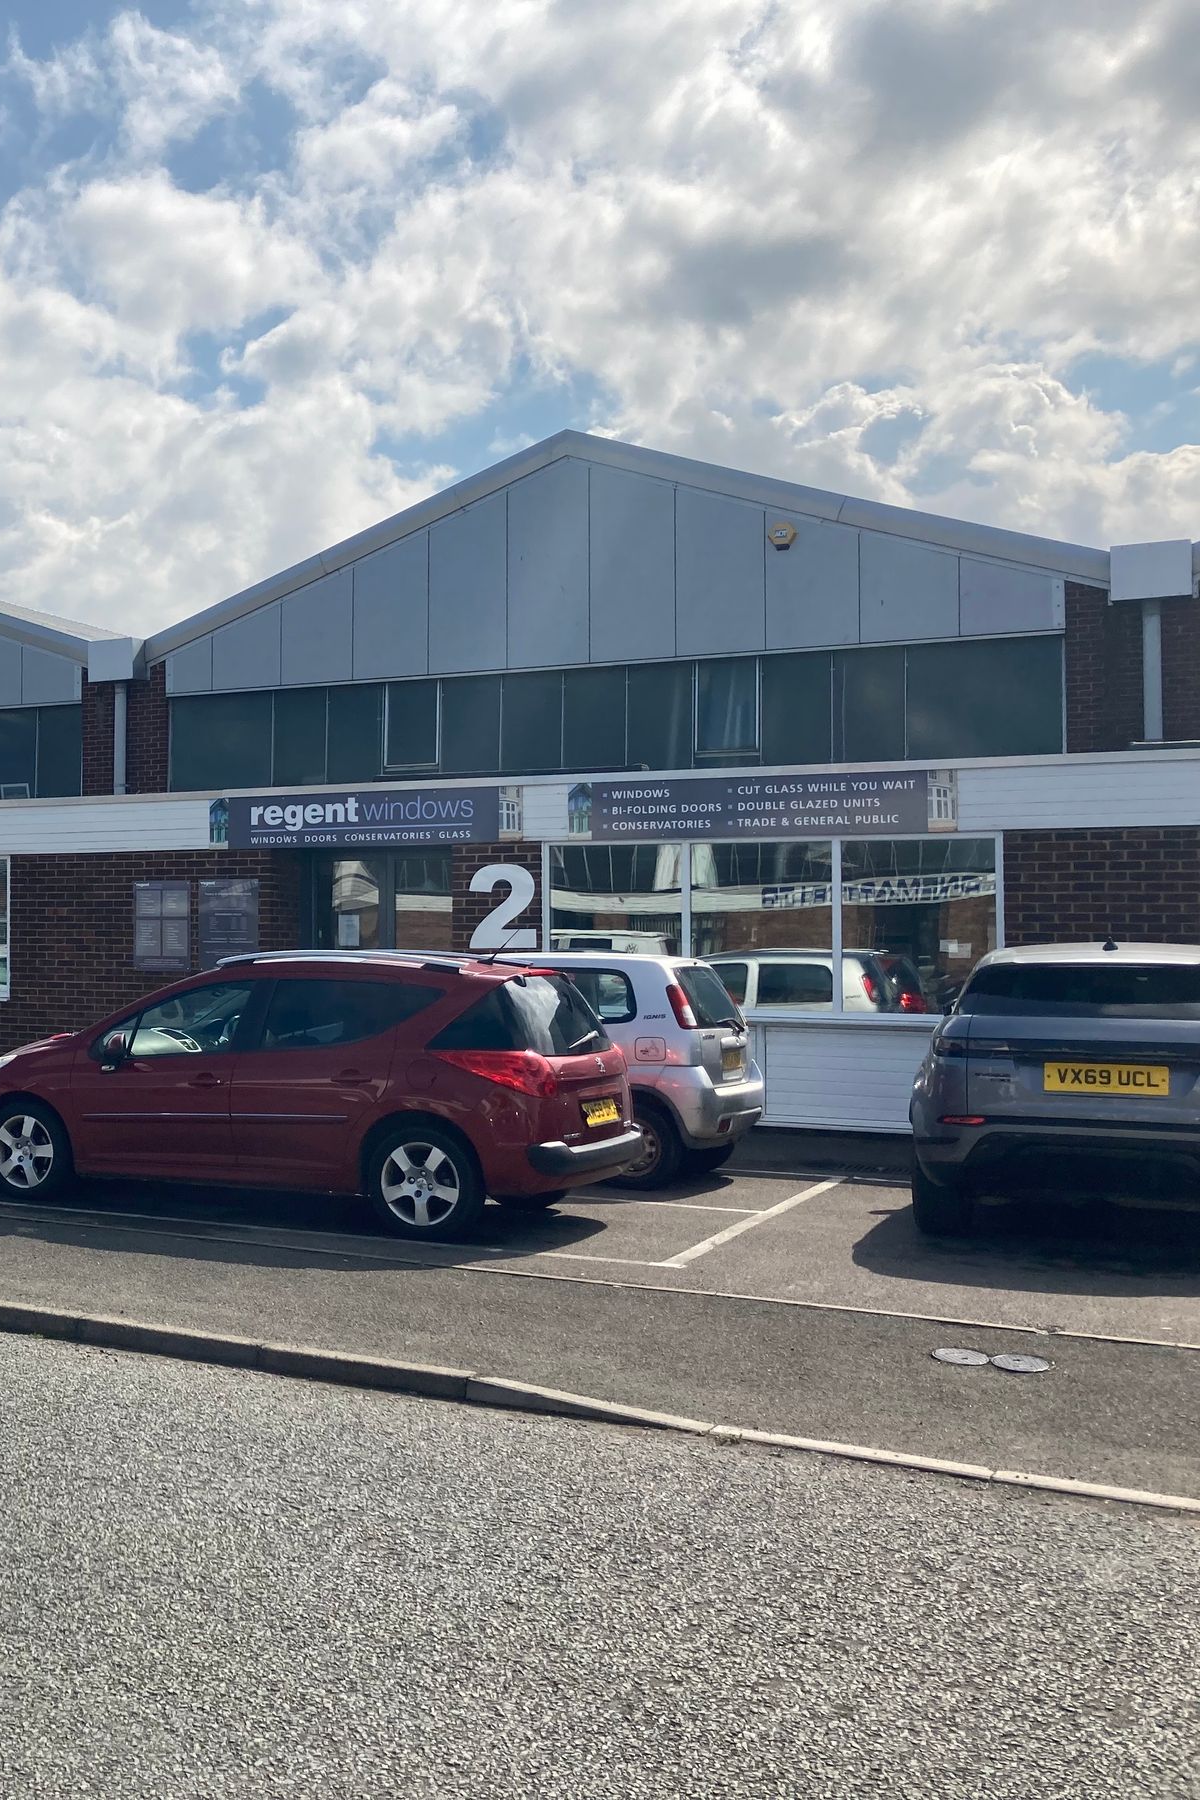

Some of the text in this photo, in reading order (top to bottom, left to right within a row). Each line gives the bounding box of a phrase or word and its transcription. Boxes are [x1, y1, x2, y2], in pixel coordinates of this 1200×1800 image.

[611, 787, 671, 800] WINDOWS
[737, 779, 916, 795] CUT GLASS WHILE YOU WAIT
[611, 803, 722, 816] BI-FOLDING DOORS
[737, 797, 881, 812] DOUBLE GLAZED UNITS
[250, 796, 474, 831] regent windows
[737, 814, 899, 828] TRADE & GENERAL PUBLIC
[611, 818, 711, 831] CONSERVATORIES
[250, 830, 471, 845] WINDOWS DOORS CONSERVATORIES GLASS
[469, 863, 537, 949] 2
[1057, 1068, 1160, 1088] VX69 UCL
